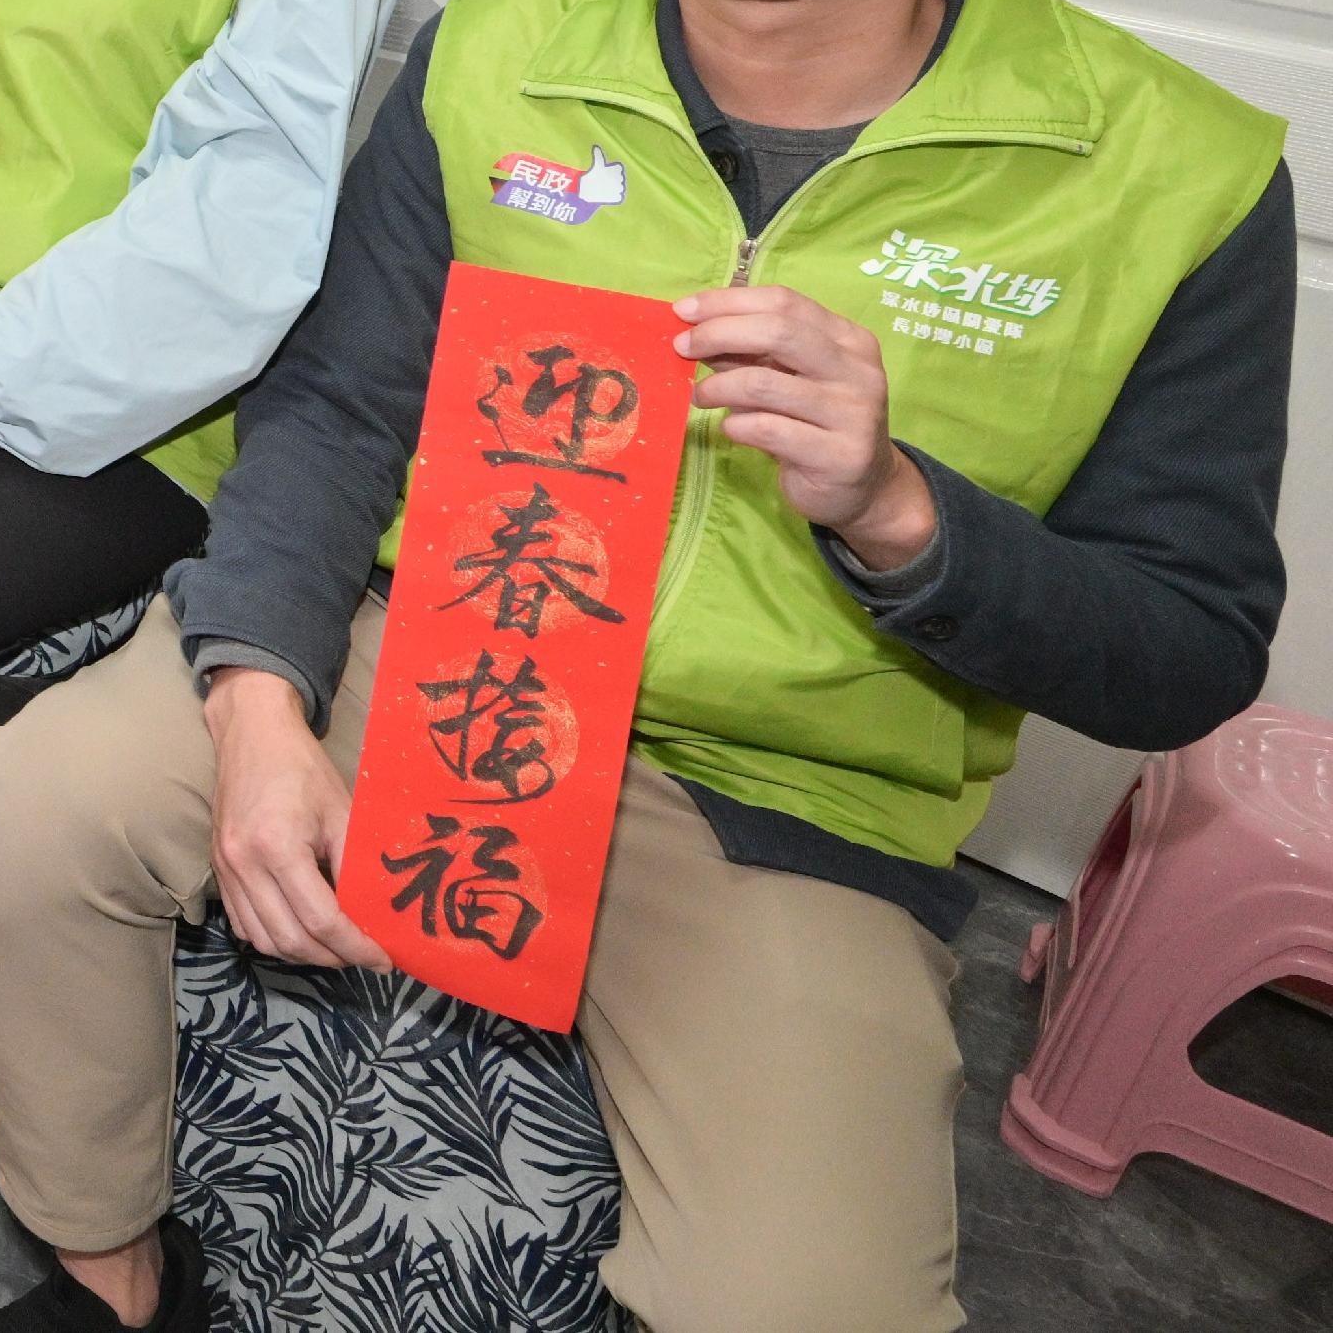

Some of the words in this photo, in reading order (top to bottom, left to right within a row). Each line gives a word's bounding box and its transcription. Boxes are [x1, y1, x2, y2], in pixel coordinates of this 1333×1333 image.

[510, 159, 573, 197] 民政
[506, 186, 577, 223] 幫到你
[380, 345, 640, 962] 迎春接福
